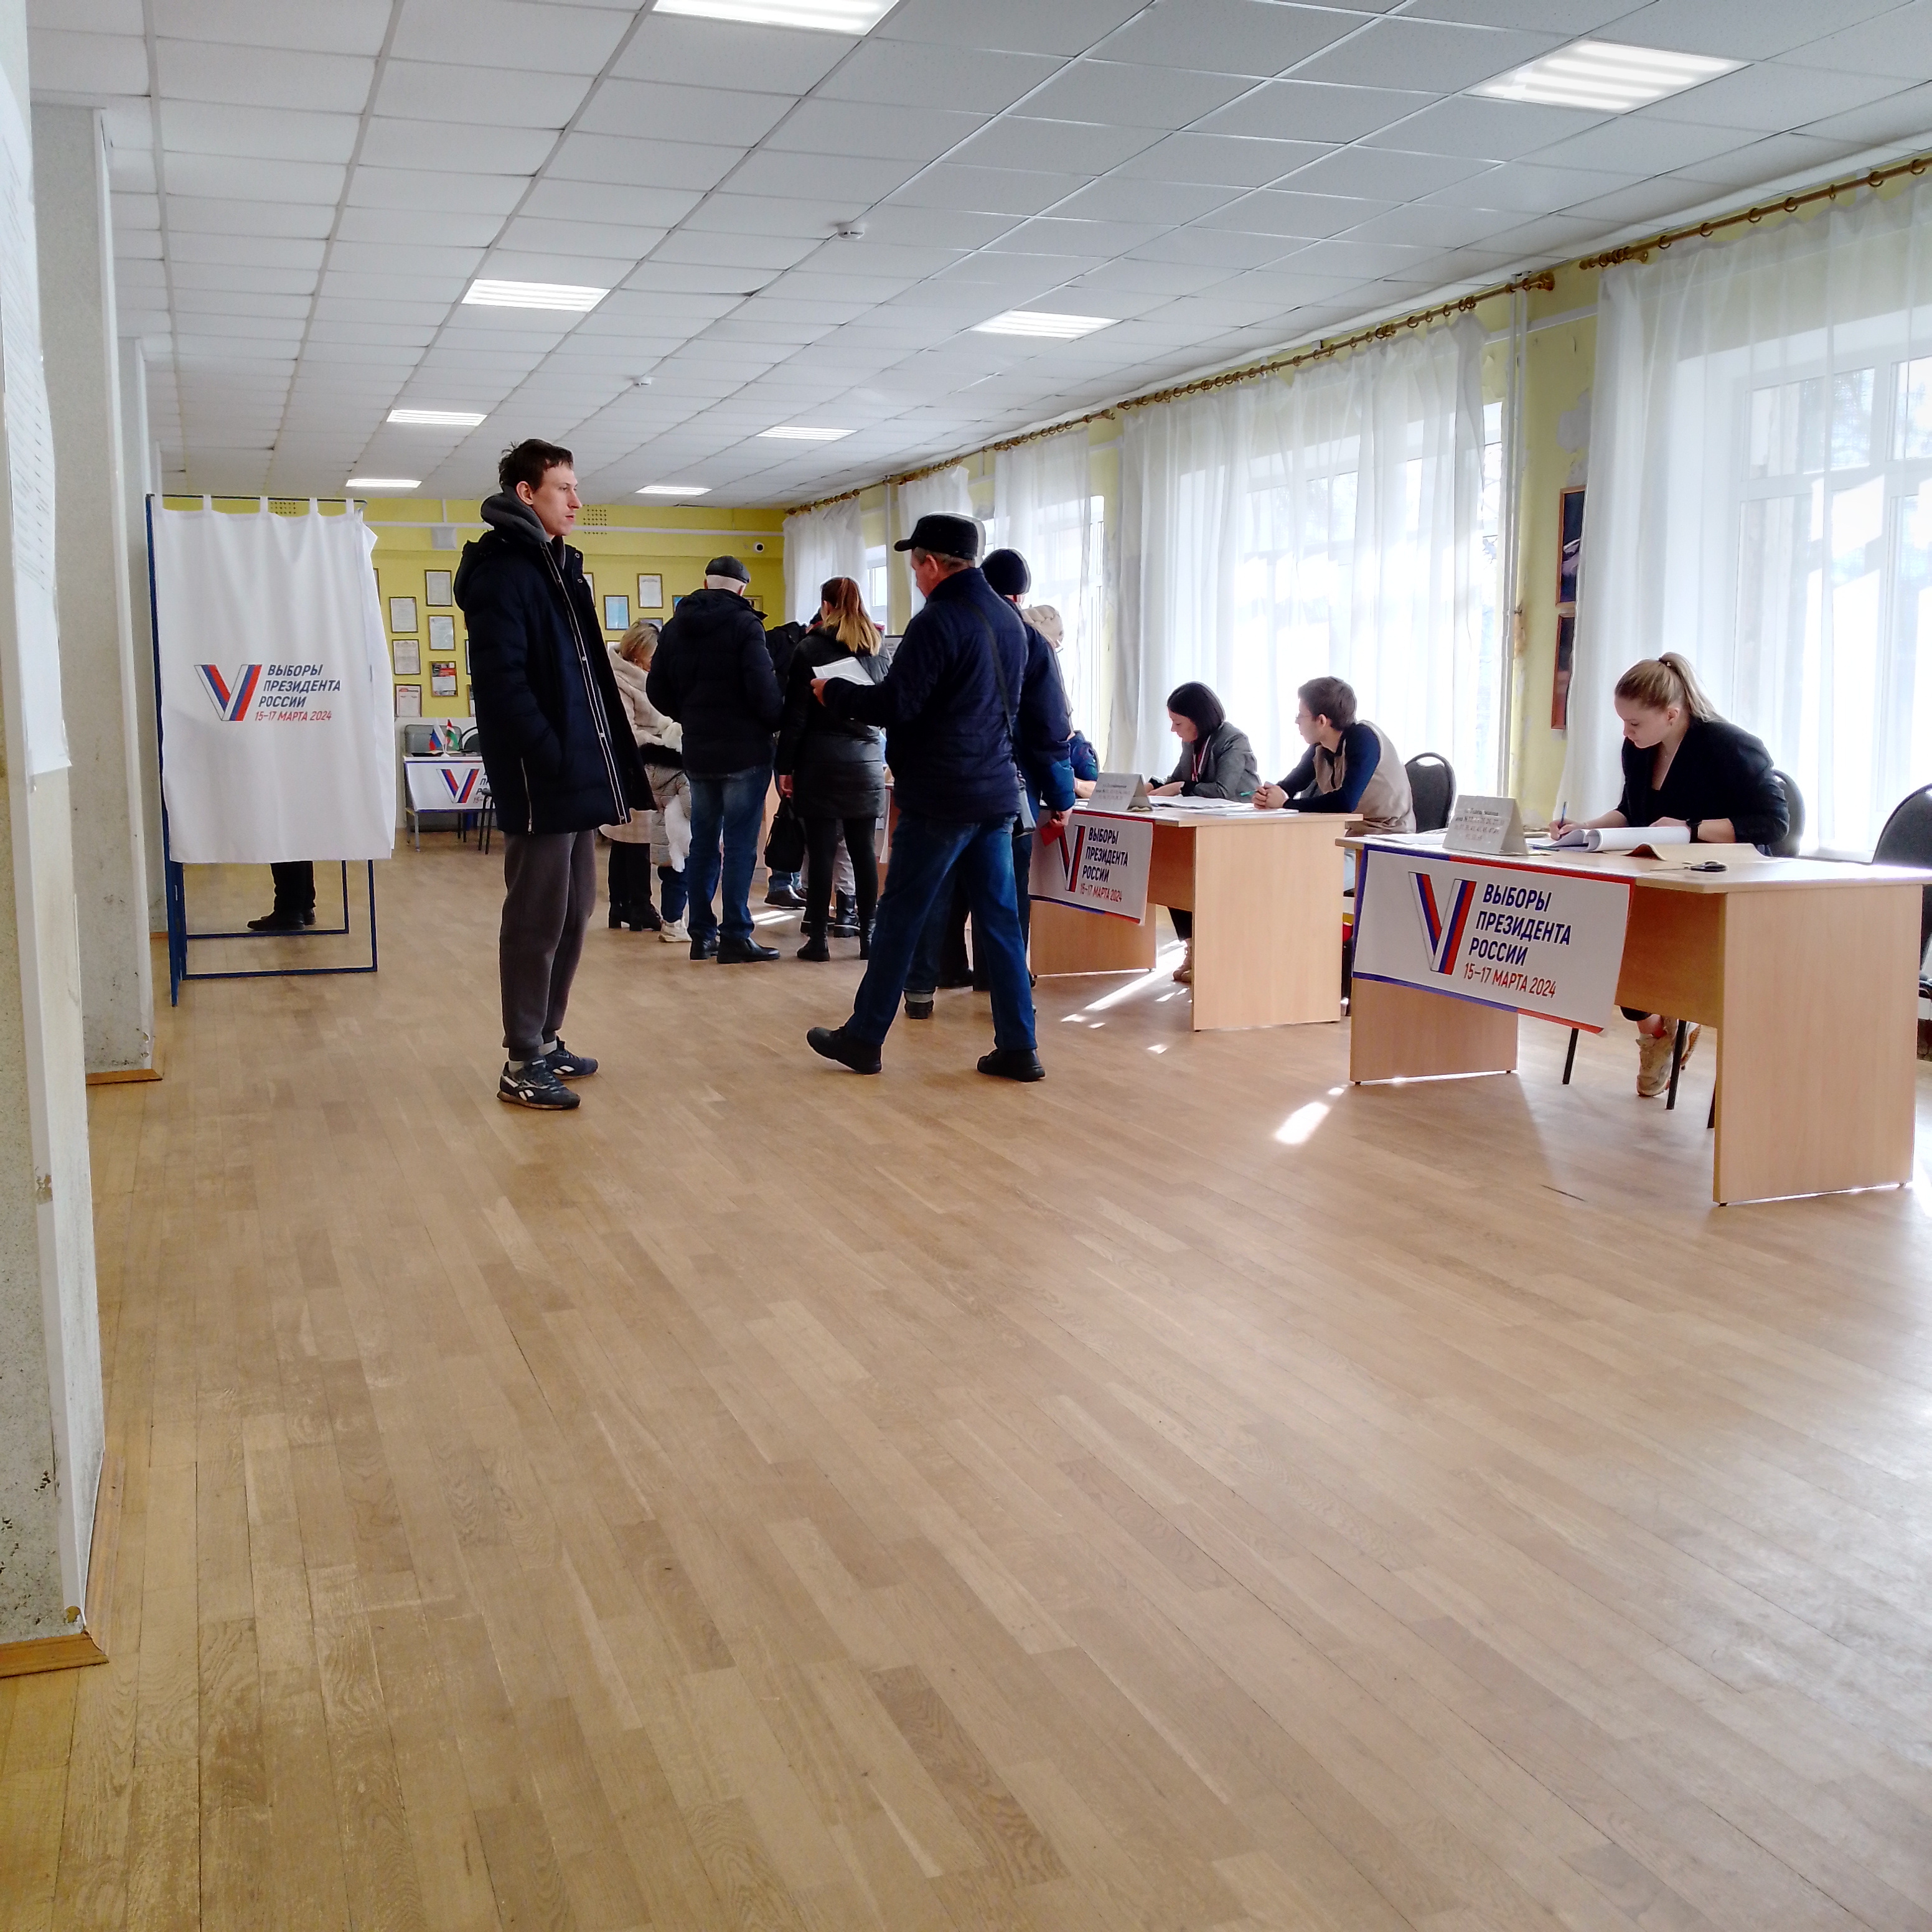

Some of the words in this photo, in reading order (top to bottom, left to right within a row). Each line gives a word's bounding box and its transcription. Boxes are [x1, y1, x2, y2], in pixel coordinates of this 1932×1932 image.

[268, 664, 323, 677] ВЫБОРЫ
[263, 680, 340, 693] ПРЕЗИДЕНТА
[258, 696, 306, 708] РОССИИ
[278, 711, 307, 721] МАРТА
[309, 710, 332, 721] 2024
[1089, 827, 1119, 845] ВЫБОРЫ
[1086, 846, 1128, 866] ПРЕЗИДЕНТА
[1082, 865, 1110, 883] РОССИИ
[1093, 886, 1110, 899] МАРТА
[1483, 884, 1552, 912] ВЫБОРЫ
[1476, 911, 1571, 945] ПРЕЗИДЕНТА
[1468, 937, 1528, 966] РОССИИ
[1492, 969, 1528, 992] МАРТА
[1529, 977, 1556, 998] 2024
